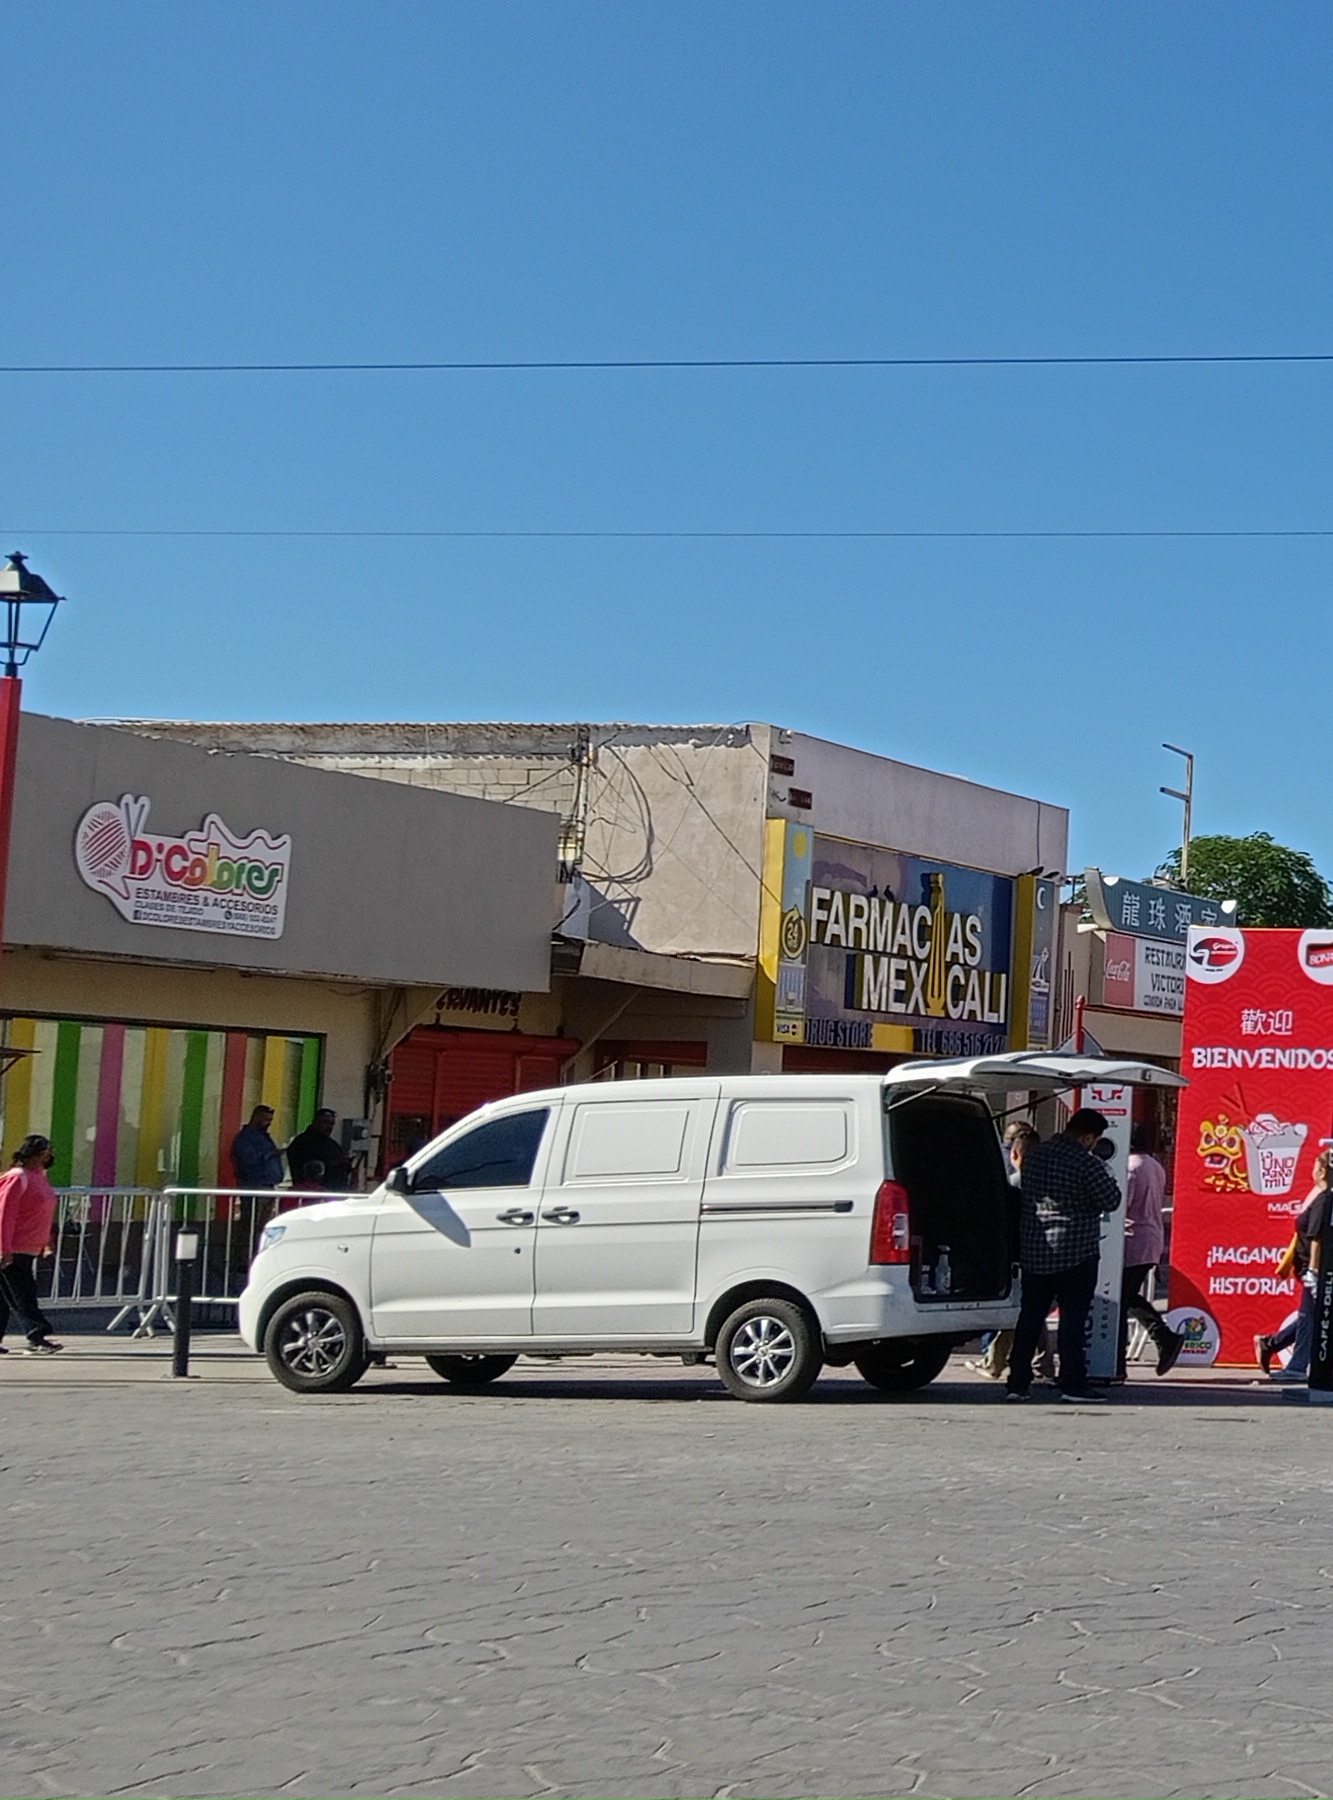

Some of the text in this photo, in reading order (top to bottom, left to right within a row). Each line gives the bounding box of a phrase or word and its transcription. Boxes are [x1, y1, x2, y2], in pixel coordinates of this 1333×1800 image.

[135, 887, 200, 905] ESTAMBRES
[211, 898, 279, 916] ACCESORIOS
[1105, 958, 1132, 982] Coca-Cola
[1144, 946, 1185, 970] RESTAUR
[862, 953, 1007, 1024] MEXICALI
[1150, 972, 1185, 995] VICTORI
[1240, 1008, 1293, 1036] 歡迎
[1261, 1157, 1296, 1171] UNO
[1206, 1246, 1290, 1268] ¡HAGAMO
[1208, 1276, 1296, 1296] HISTORIA!
